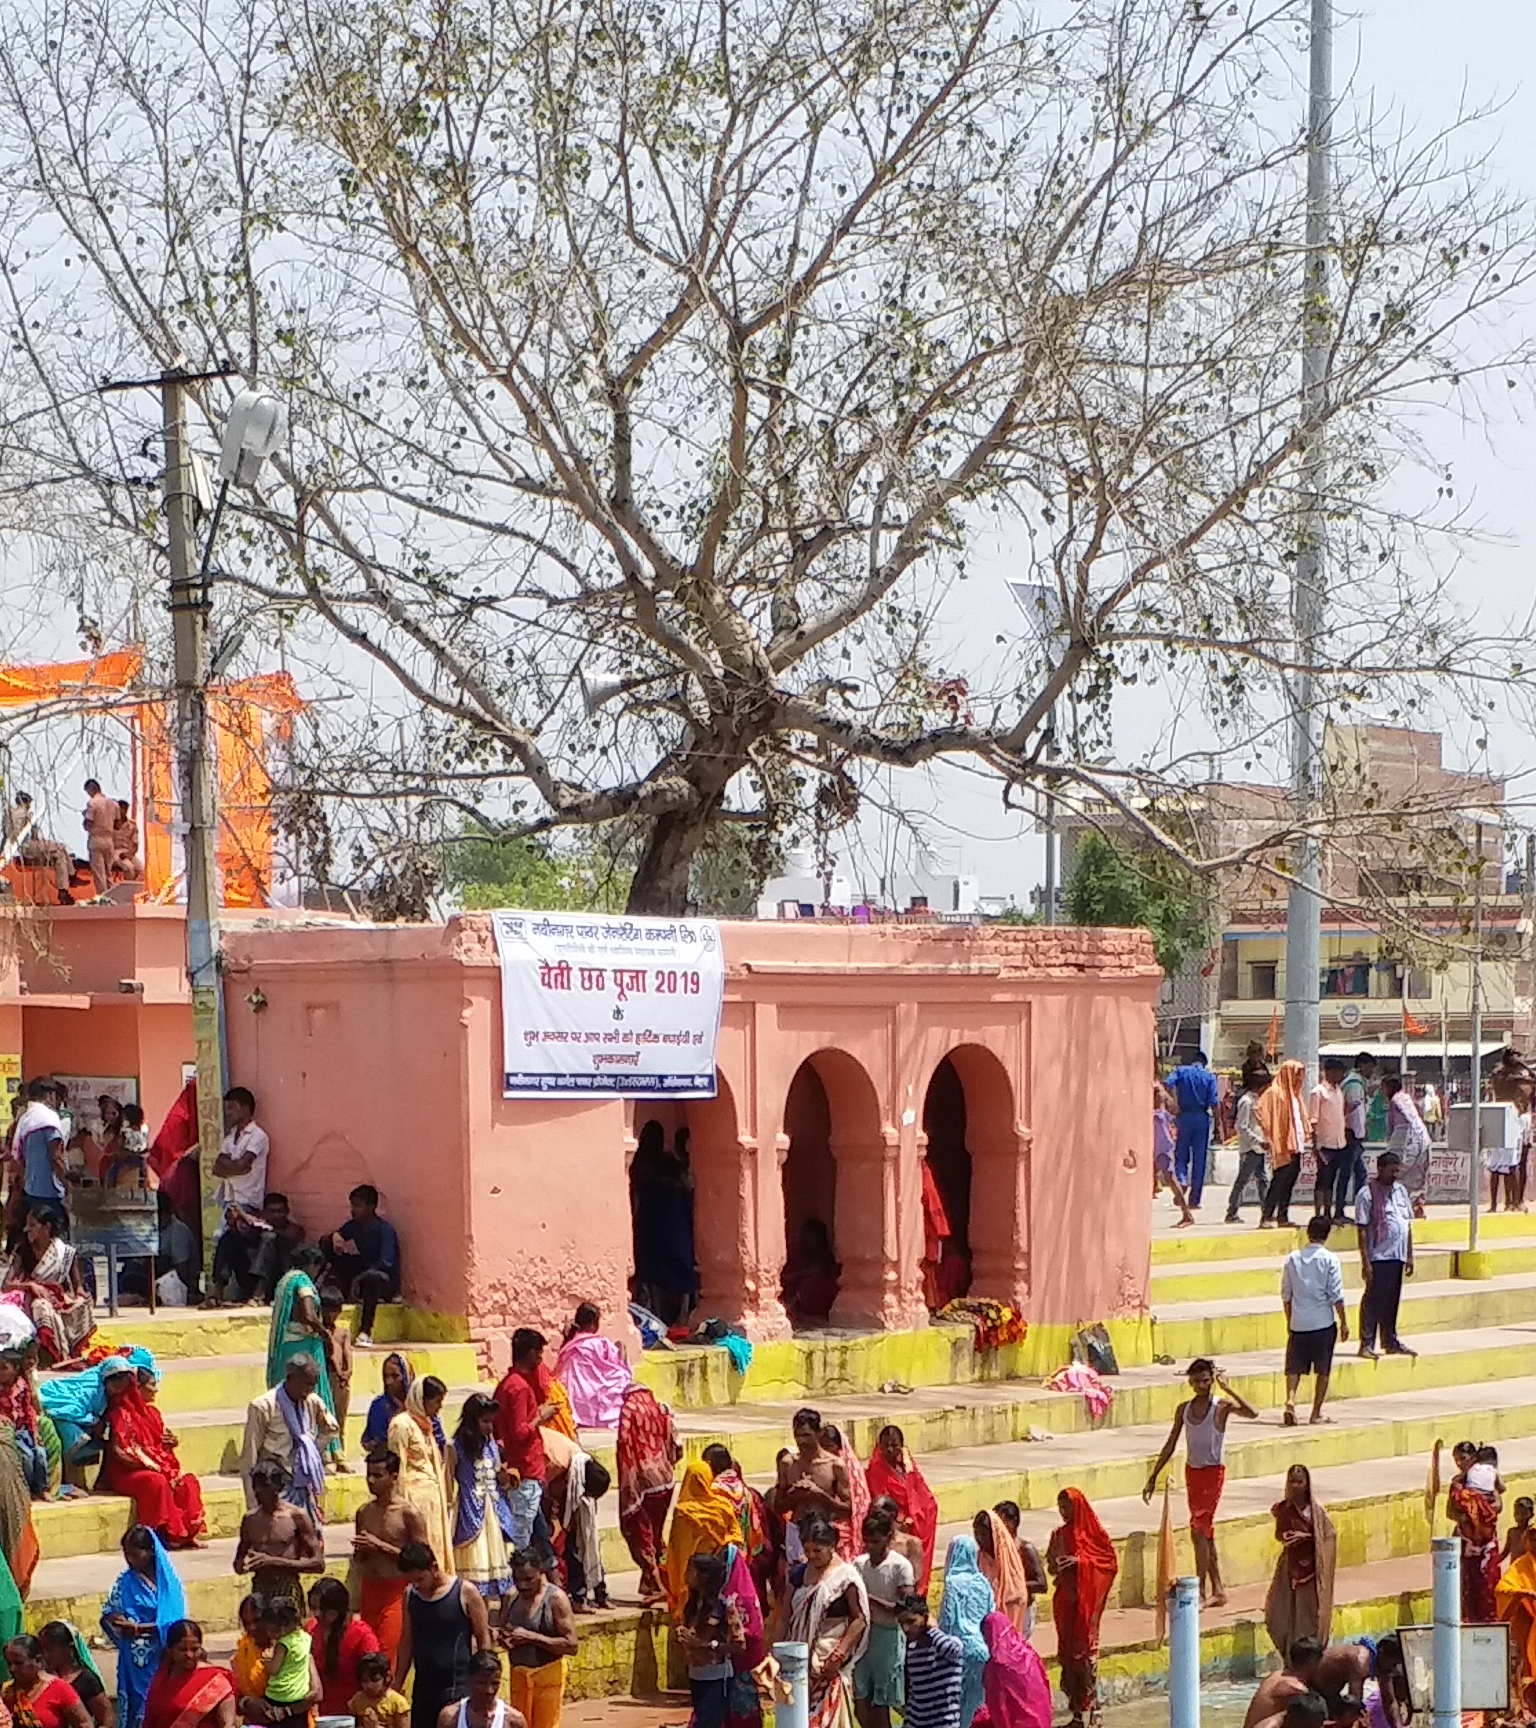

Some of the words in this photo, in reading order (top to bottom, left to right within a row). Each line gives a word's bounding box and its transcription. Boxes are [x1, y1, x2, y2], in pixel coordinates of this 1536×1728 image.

[537, 958, 573, 991] चैती
[578, 968, 607, 991] छठ
[611, 969, 648, 1002] पूजा
[654, 970, 701, 994] 2019
[612, 1005, 625, 1021] के
[571, 1031, 583, 1043] पर
